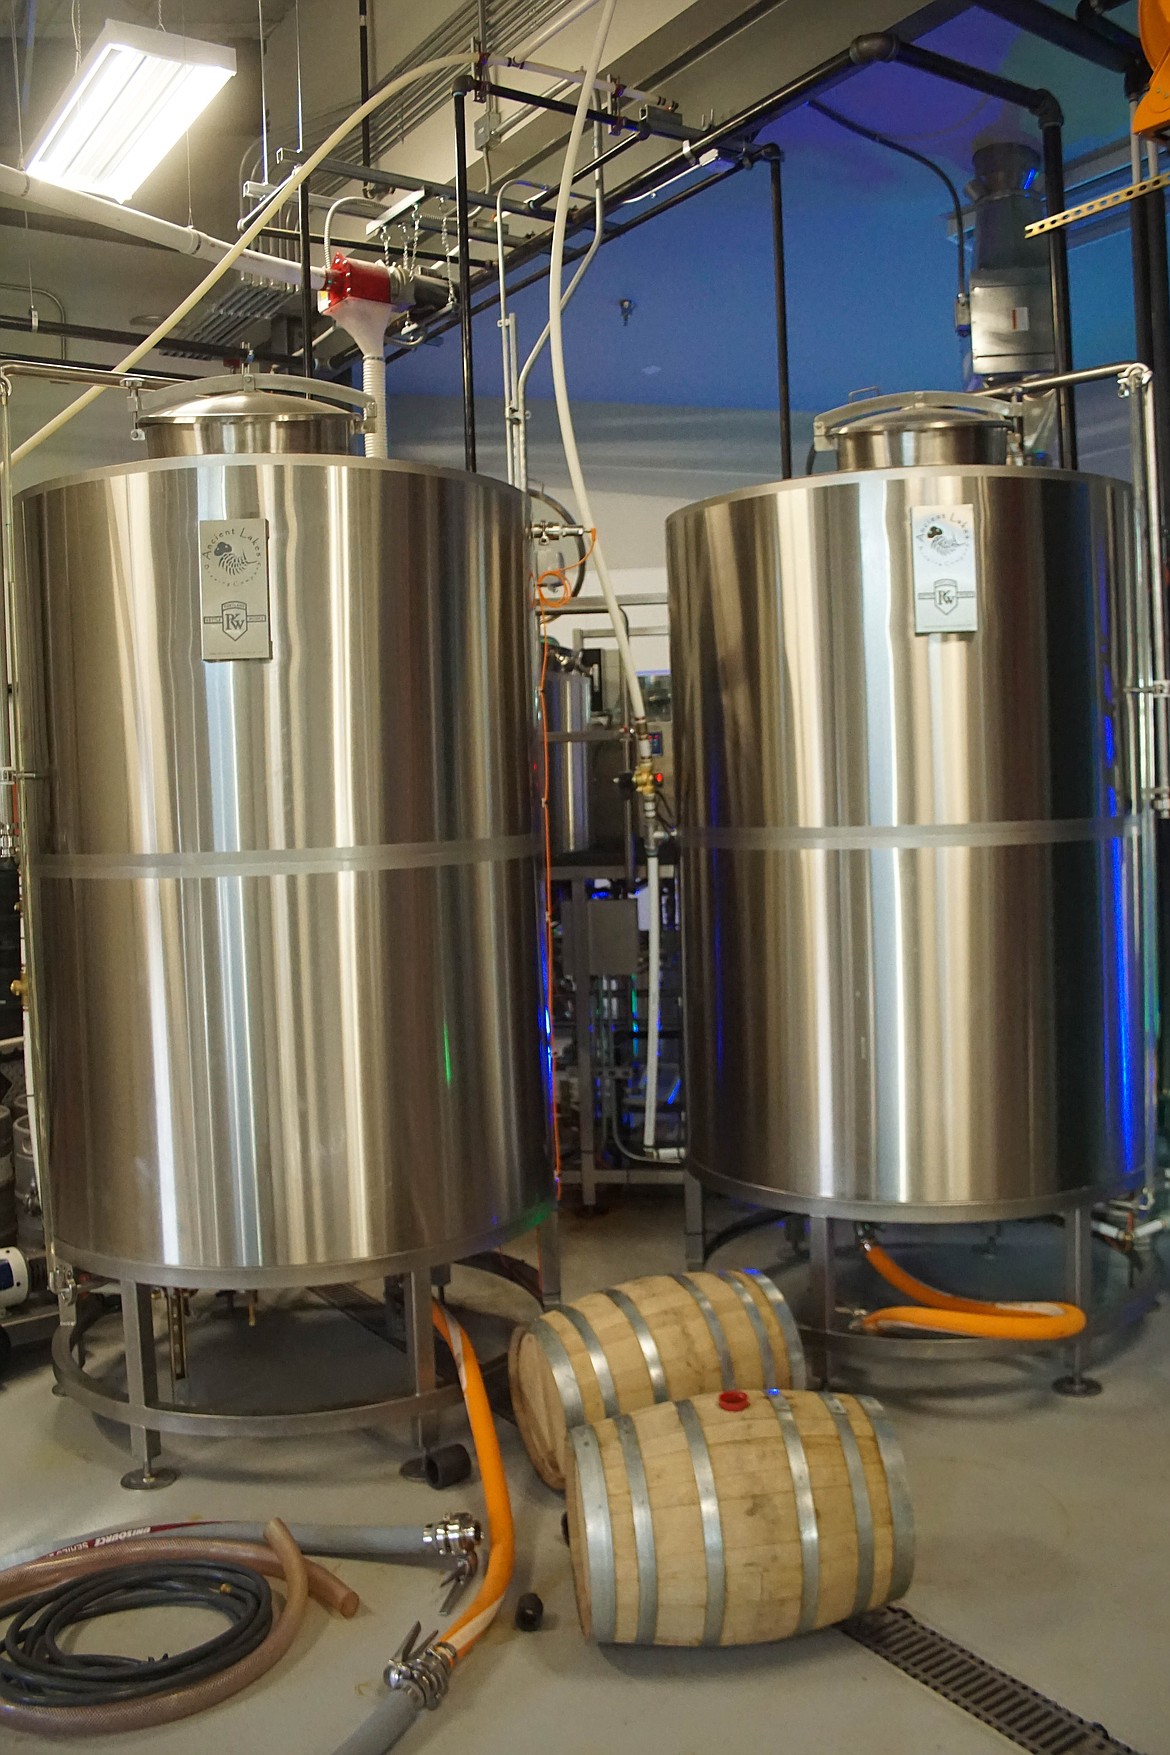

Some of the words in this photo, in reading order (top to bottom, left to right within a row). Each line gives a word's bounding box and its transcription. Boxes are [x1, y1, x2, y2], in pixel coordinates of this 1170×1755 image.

[202, 528, 235, 561] Ancient
[239, 527, 261, 557] Lakes
[94, 1527, 151, 1547] UNISOURCE
